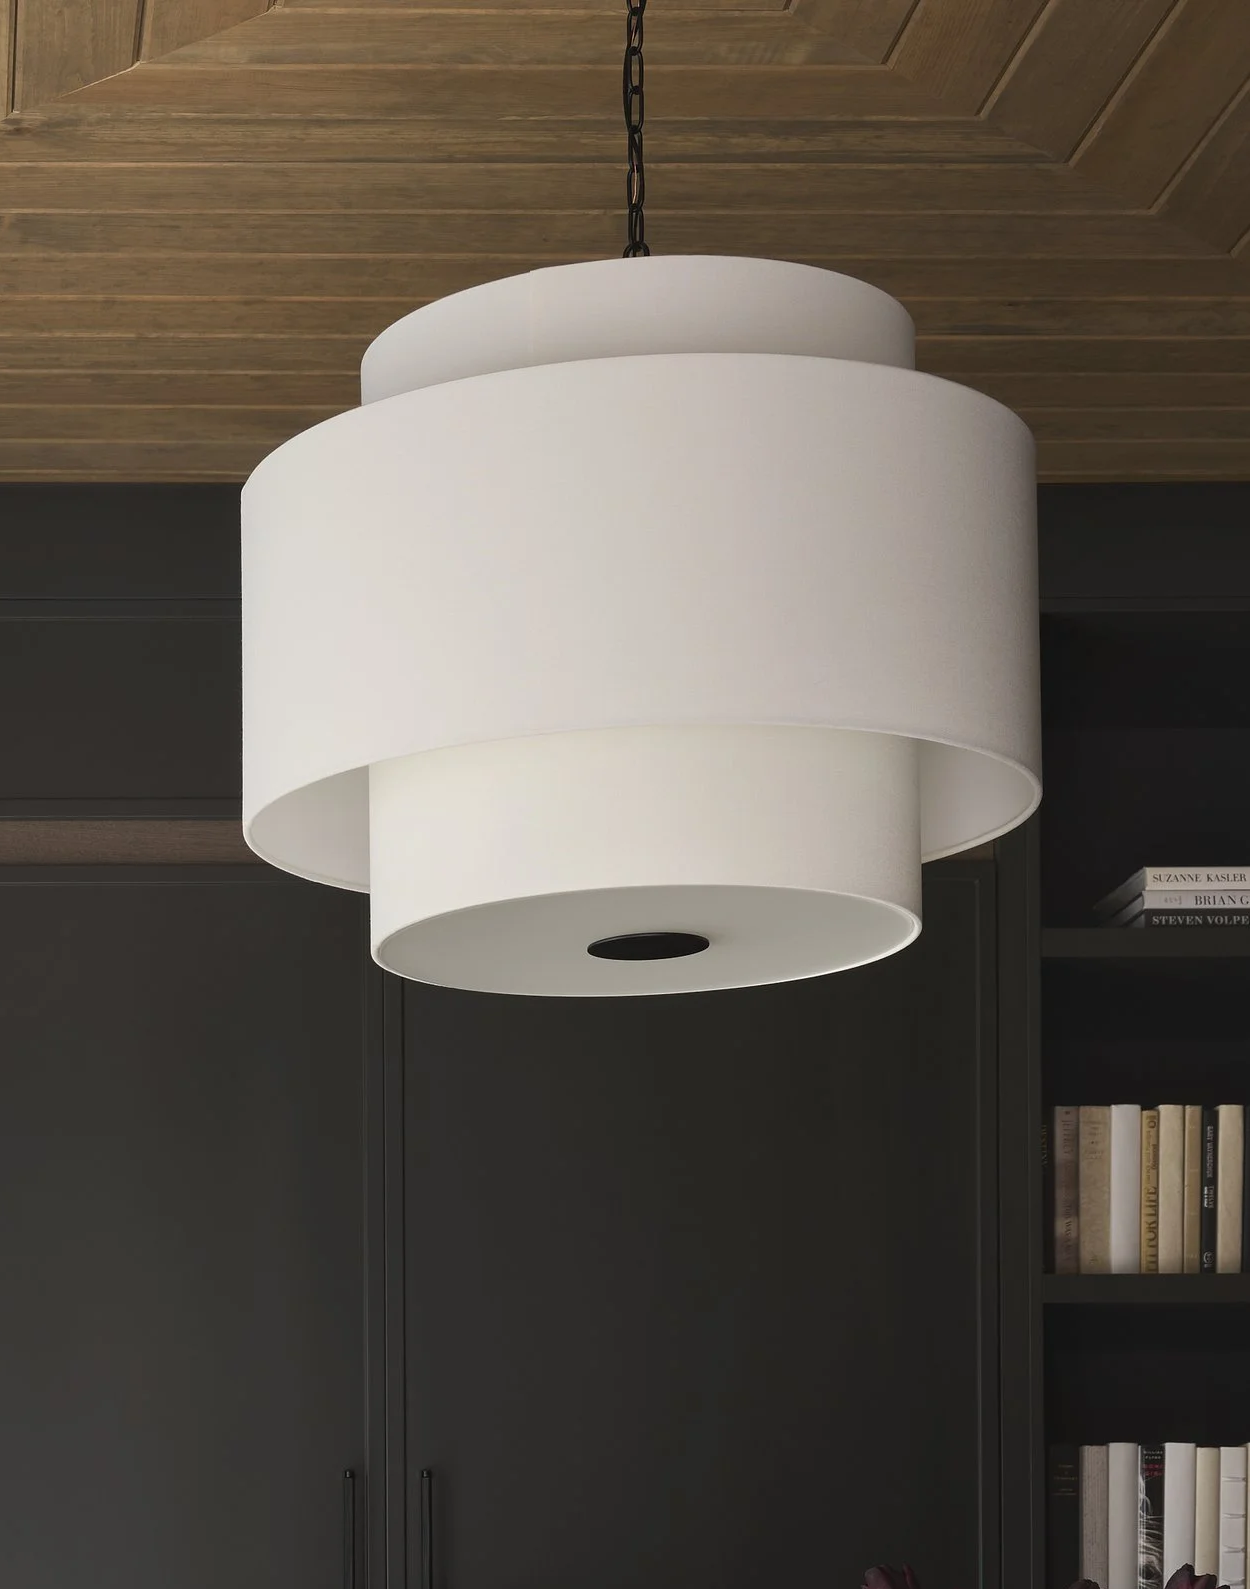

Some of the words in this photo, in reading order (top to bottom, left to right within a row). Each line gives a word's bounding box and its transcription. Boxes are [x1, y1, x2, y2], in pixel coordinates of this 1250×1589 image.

[1152, 873, 1202, 883] SUZANNE
[1206, 873, 1247, 882] KASLER
[1194, 895, 1236, 905] BRIAN
[1152, 916, 1202, 925] STEVEN
[1206, 916, 1250, 925] VOLPE
[1147, 1186, 1156, 1218] LIFE
